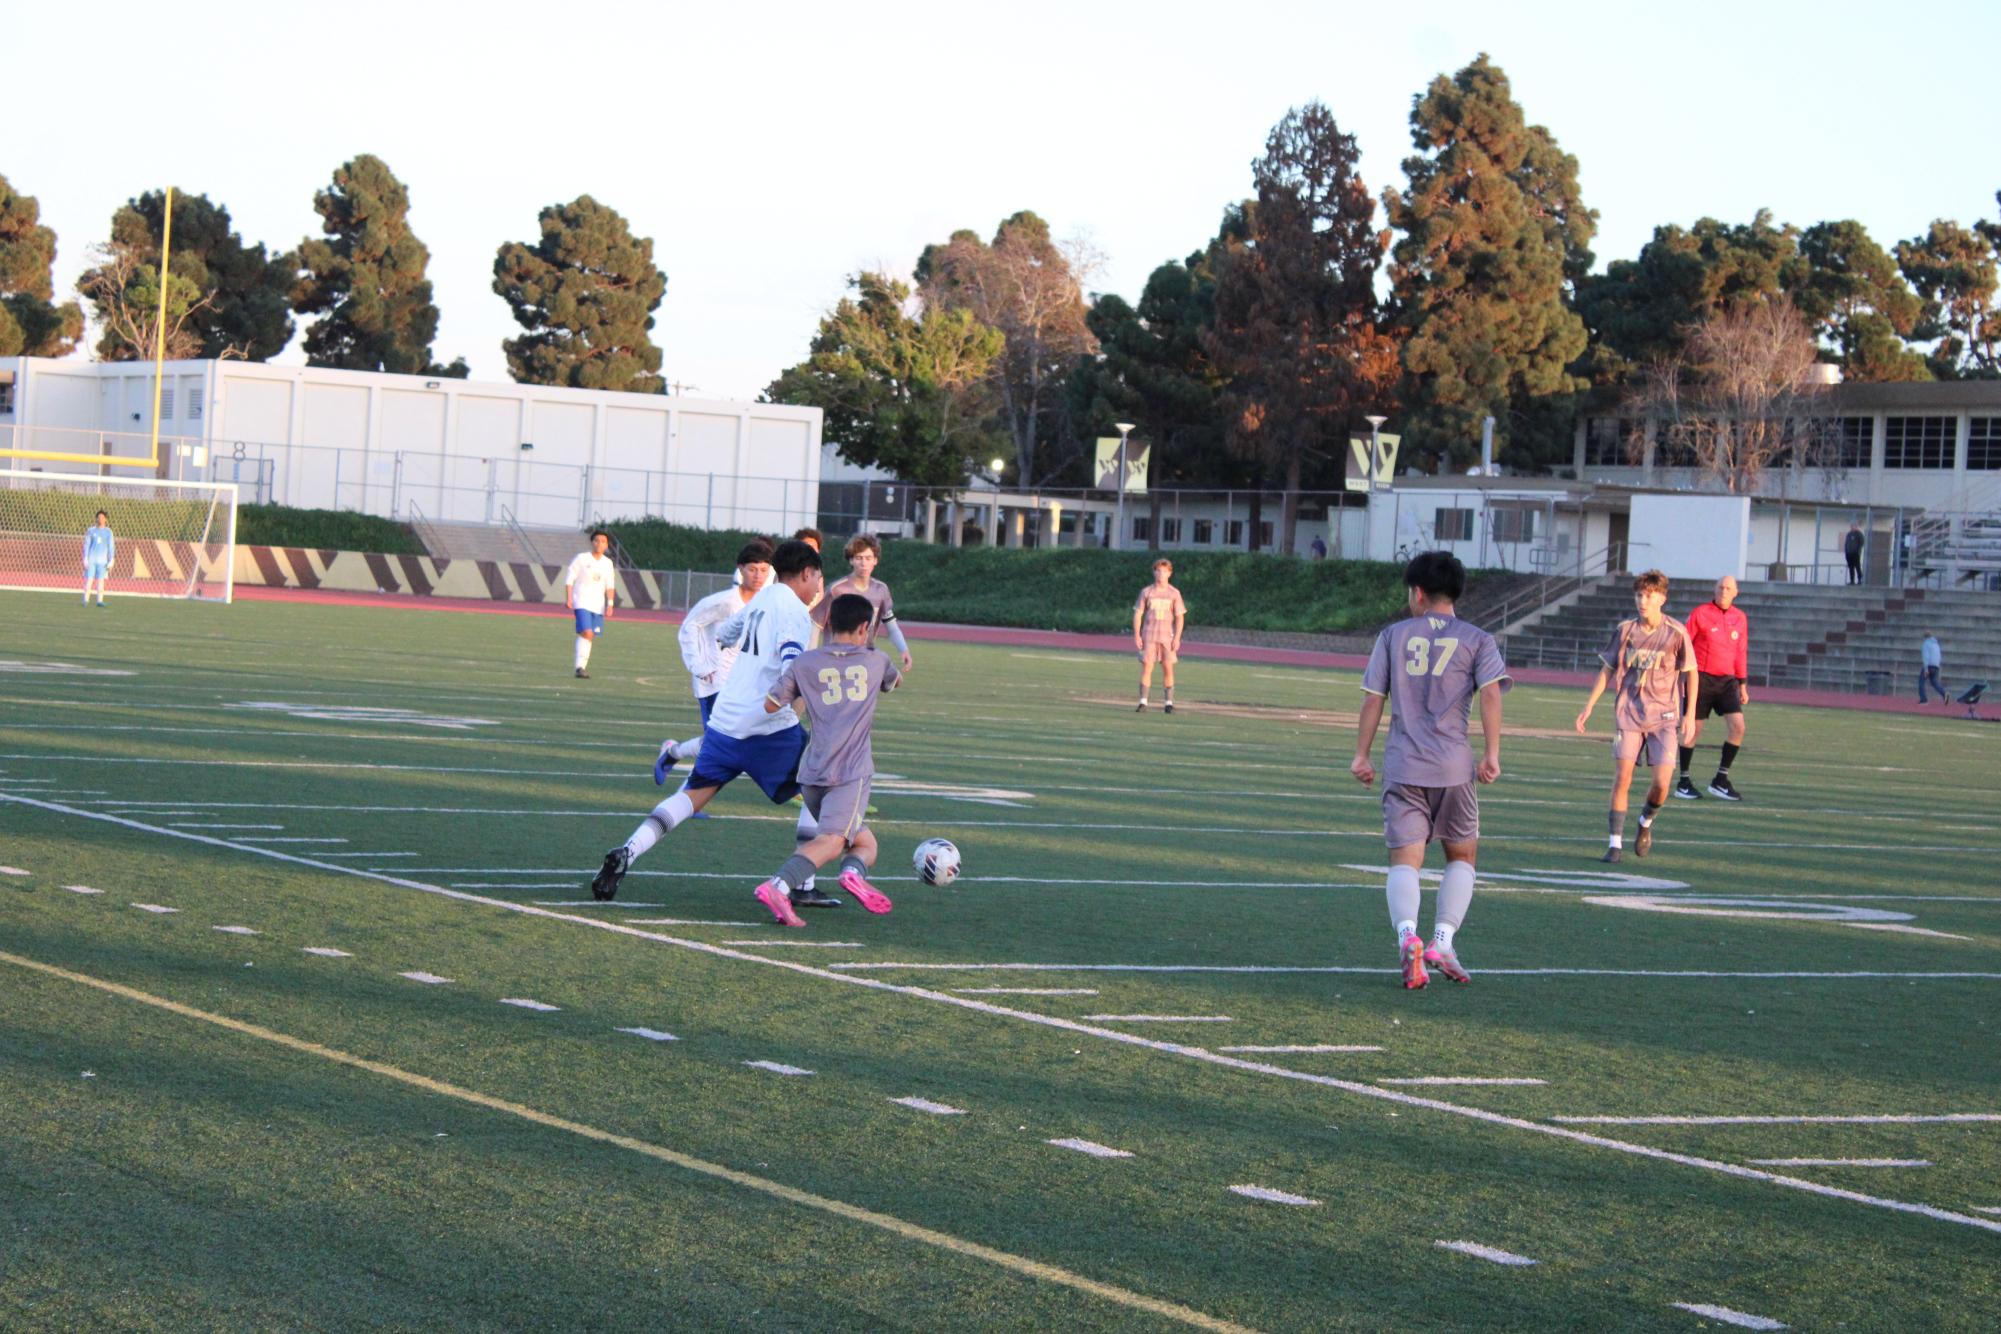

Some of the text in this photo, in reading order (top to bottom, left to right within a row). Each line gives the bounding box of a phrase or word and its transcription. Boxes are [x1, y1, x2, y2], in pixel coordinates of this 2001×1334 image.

[741, 608, 765, 656] 11
[1406, 635, 1459, 677] 37
[817, 664, 869, 705] 33
